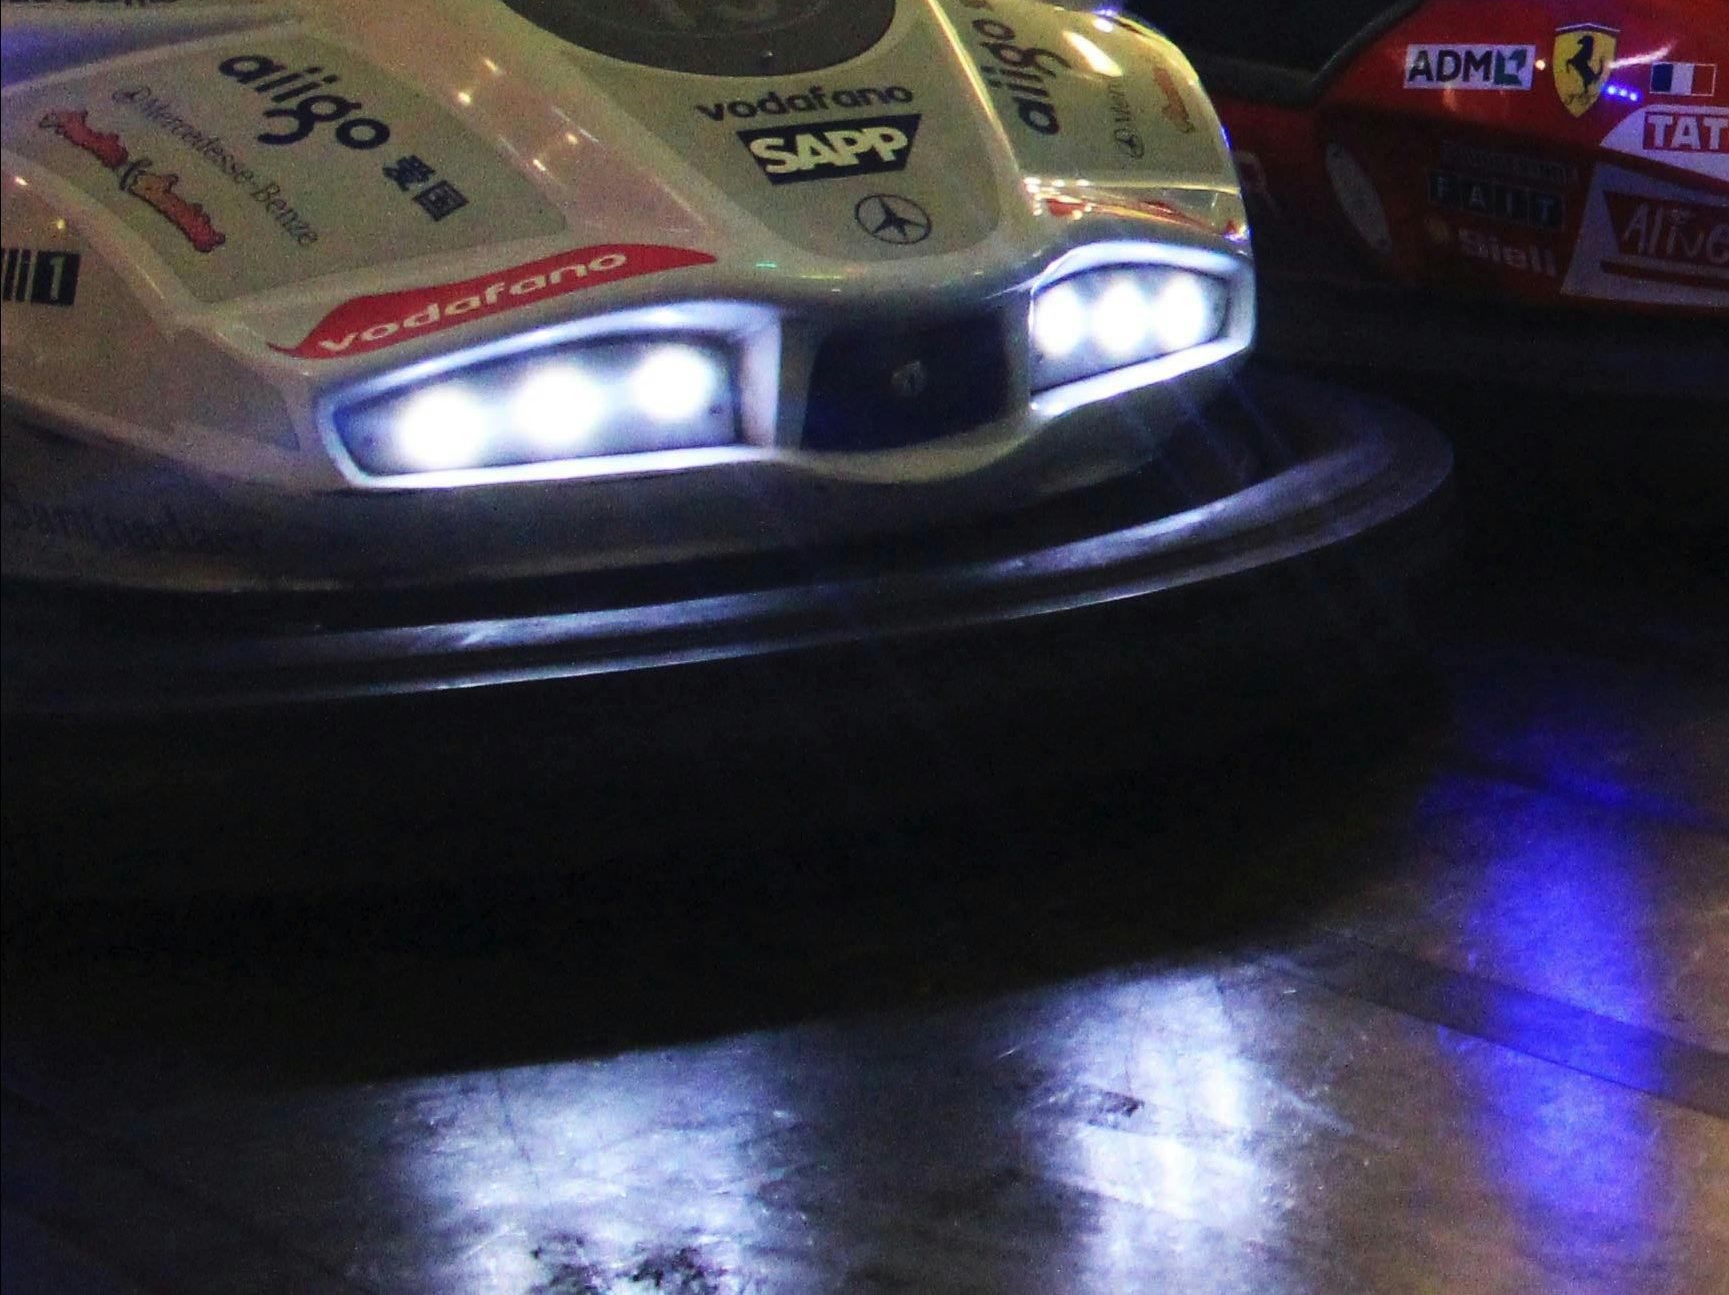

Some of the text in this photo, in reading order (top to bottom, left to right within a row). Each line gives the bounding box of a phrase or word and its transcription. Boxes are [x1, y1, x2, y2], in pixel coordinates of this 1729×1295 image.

[695, 84, 914, 122] vodafano
[750, 125, 908, 175] SAPP
[319, 246, 628, 353] vodafano
